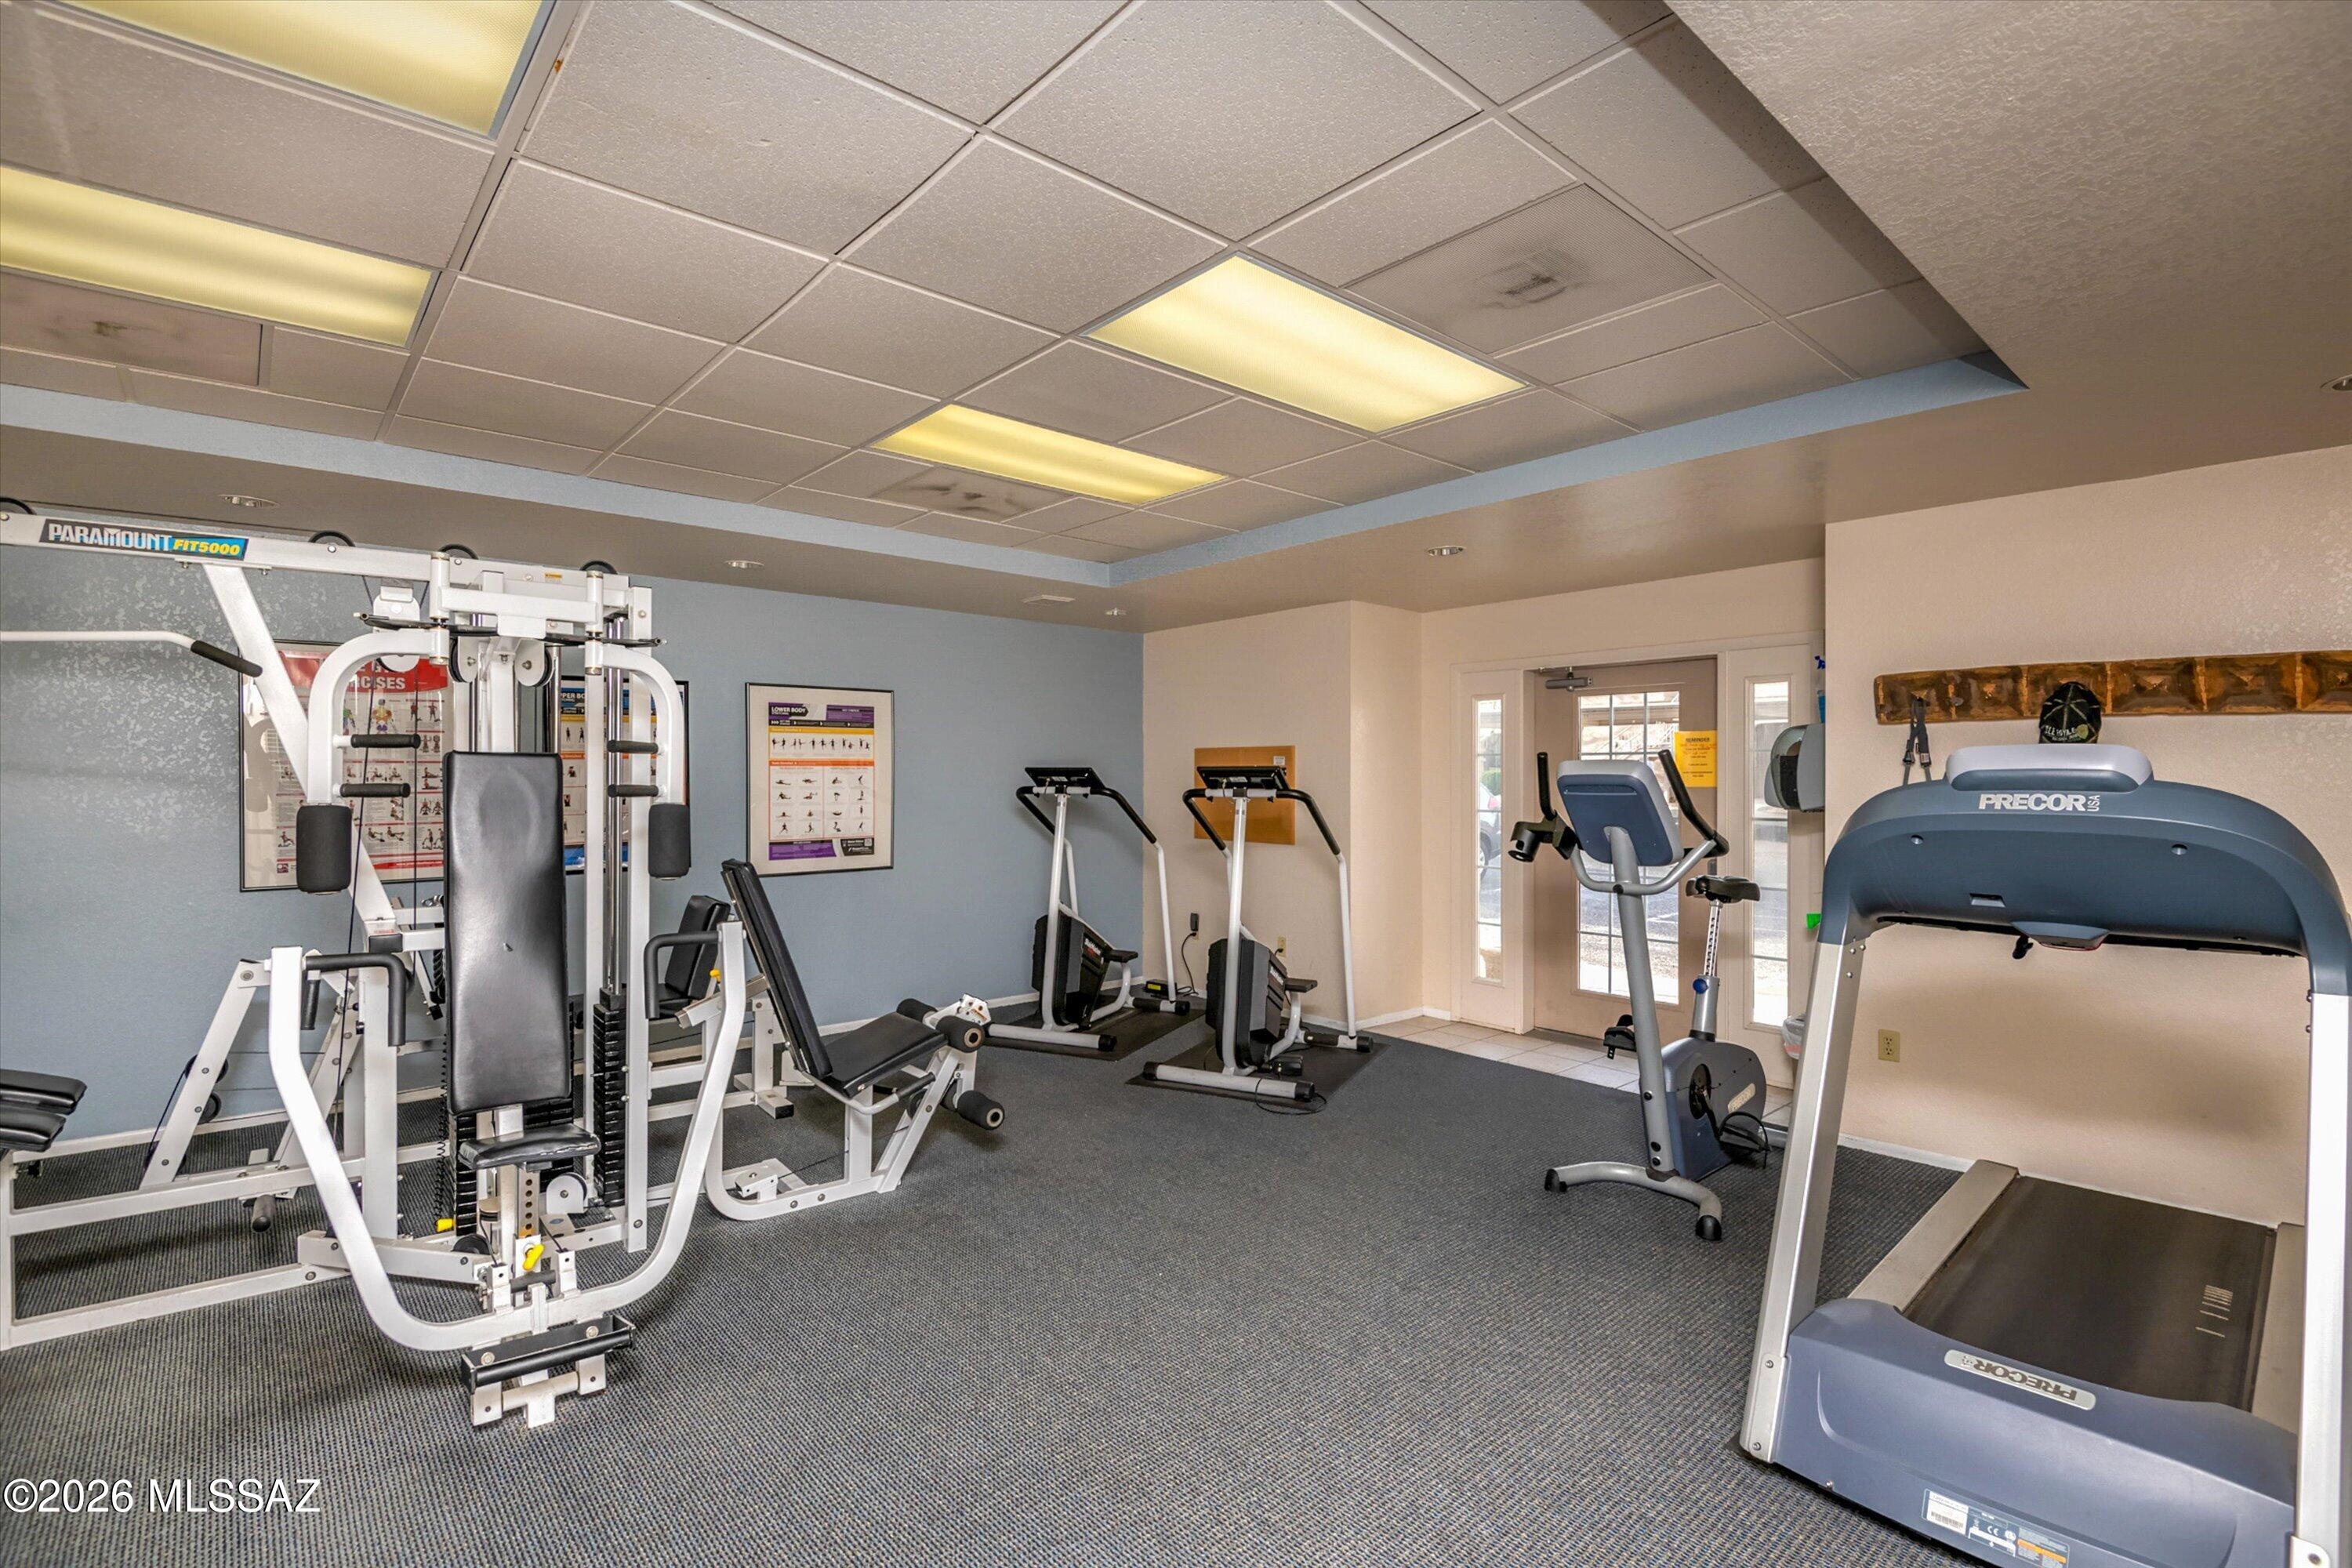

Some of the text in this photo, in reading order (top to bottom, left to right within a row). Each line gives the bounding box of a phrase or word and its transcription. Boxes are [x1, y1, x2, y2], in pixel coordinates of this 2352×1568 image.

[49, 523, 240, 555] PARAMOUNT FIT5000
[1978, 793, 2101, 811] PRECOR USA
[1973, 1359, 2078, 1401] PRECOR
